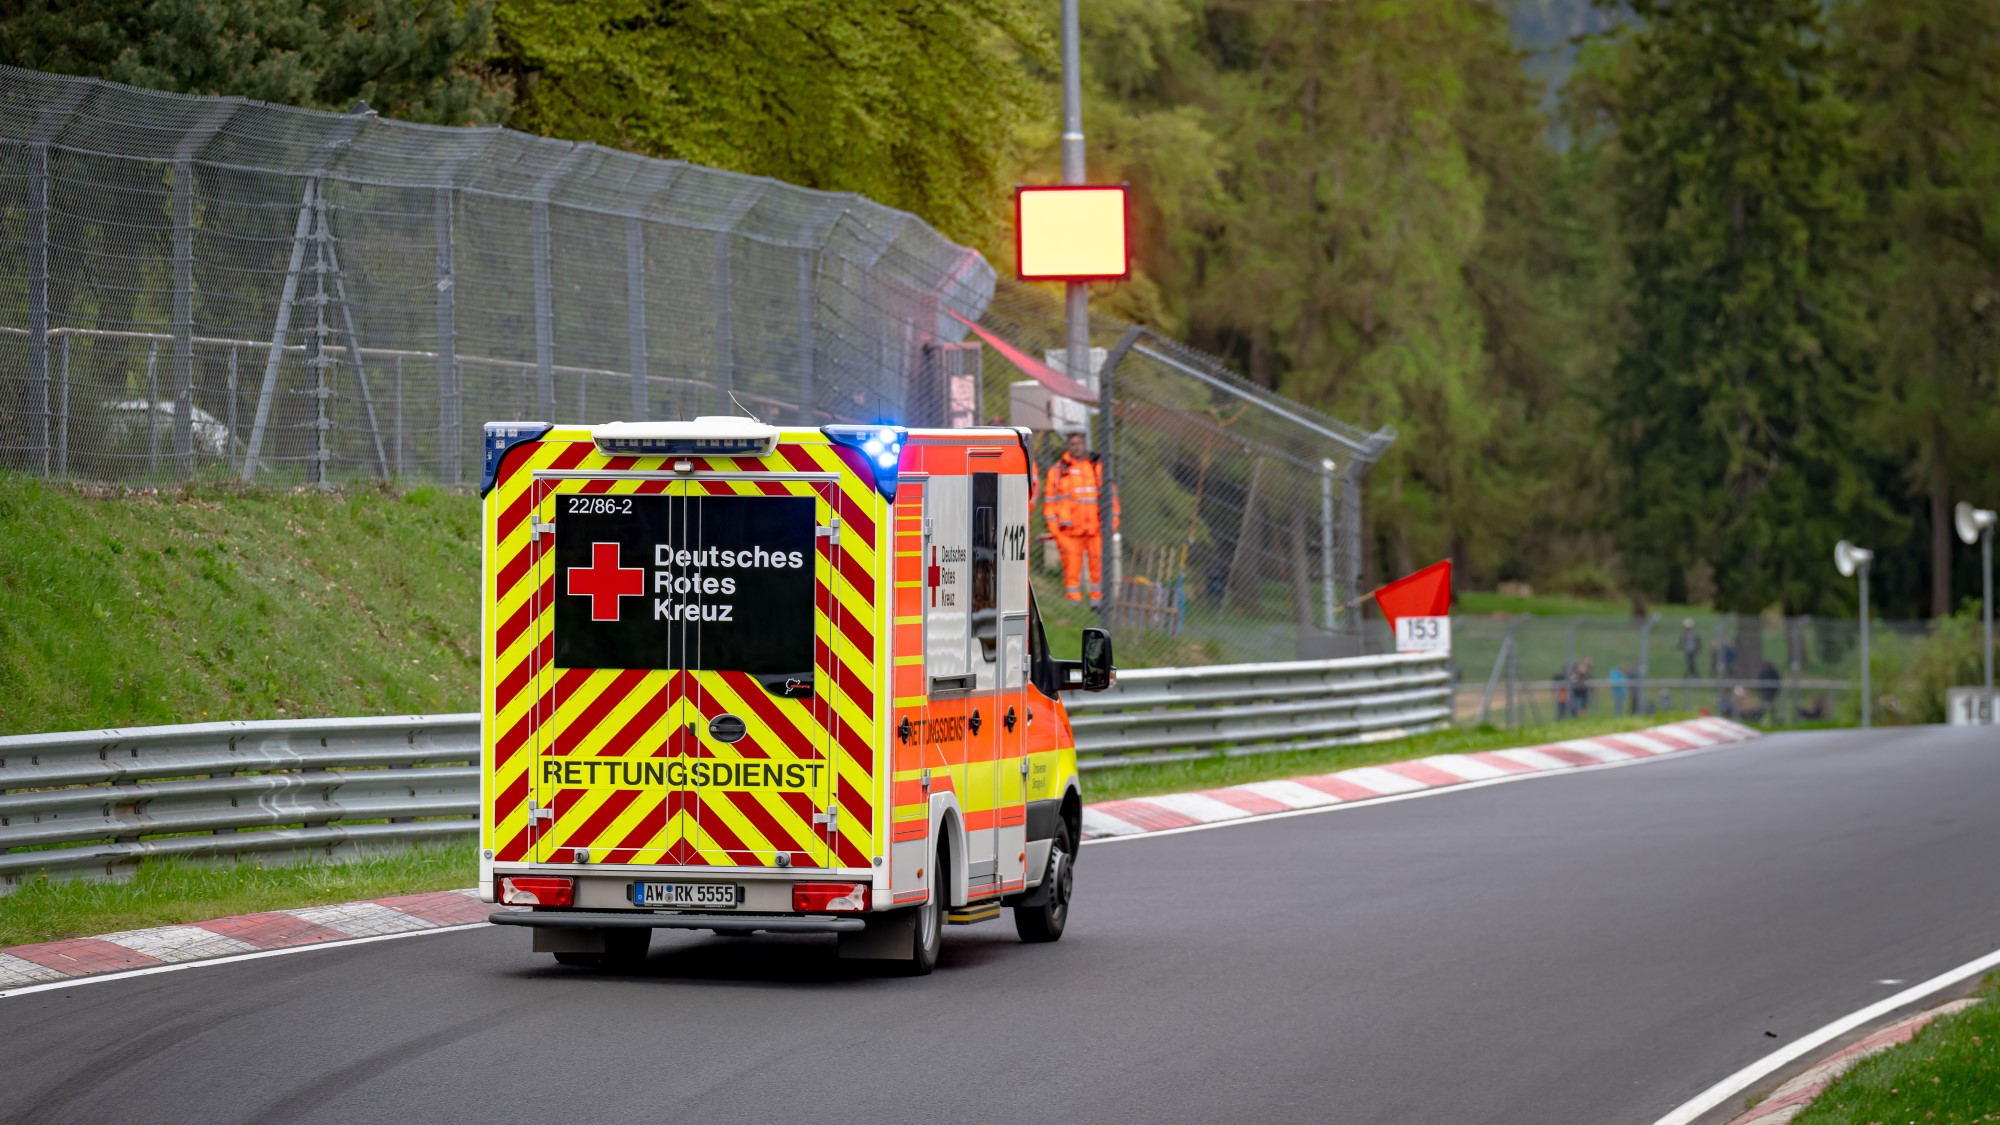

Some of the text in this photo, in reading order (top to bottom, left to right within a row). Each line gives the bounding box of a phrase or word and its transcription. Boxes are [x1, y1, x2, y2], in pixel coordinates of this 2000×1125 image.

[568, 497, 633, 514] 22/86-2
[941, 545, 966, 562] Deutsches
[1009, 524, 1026, 561] 112
[654, 543, 804, 569] Deutsches
[654, 570, 736, 595] Rotes
[941, 567, 956, 585] Rotes
[941, 588, 955, 607] Kreuz
[654, 598, 733, 622] Kreuz
[1406, 618, 1439, 640] 153
[543, 760, 825, 788] RETTUNGSDIENST
[645, 885, 664, 902] AW
[675, 885, 693, 902] RK
[697, 886, 733, 902] 5555
